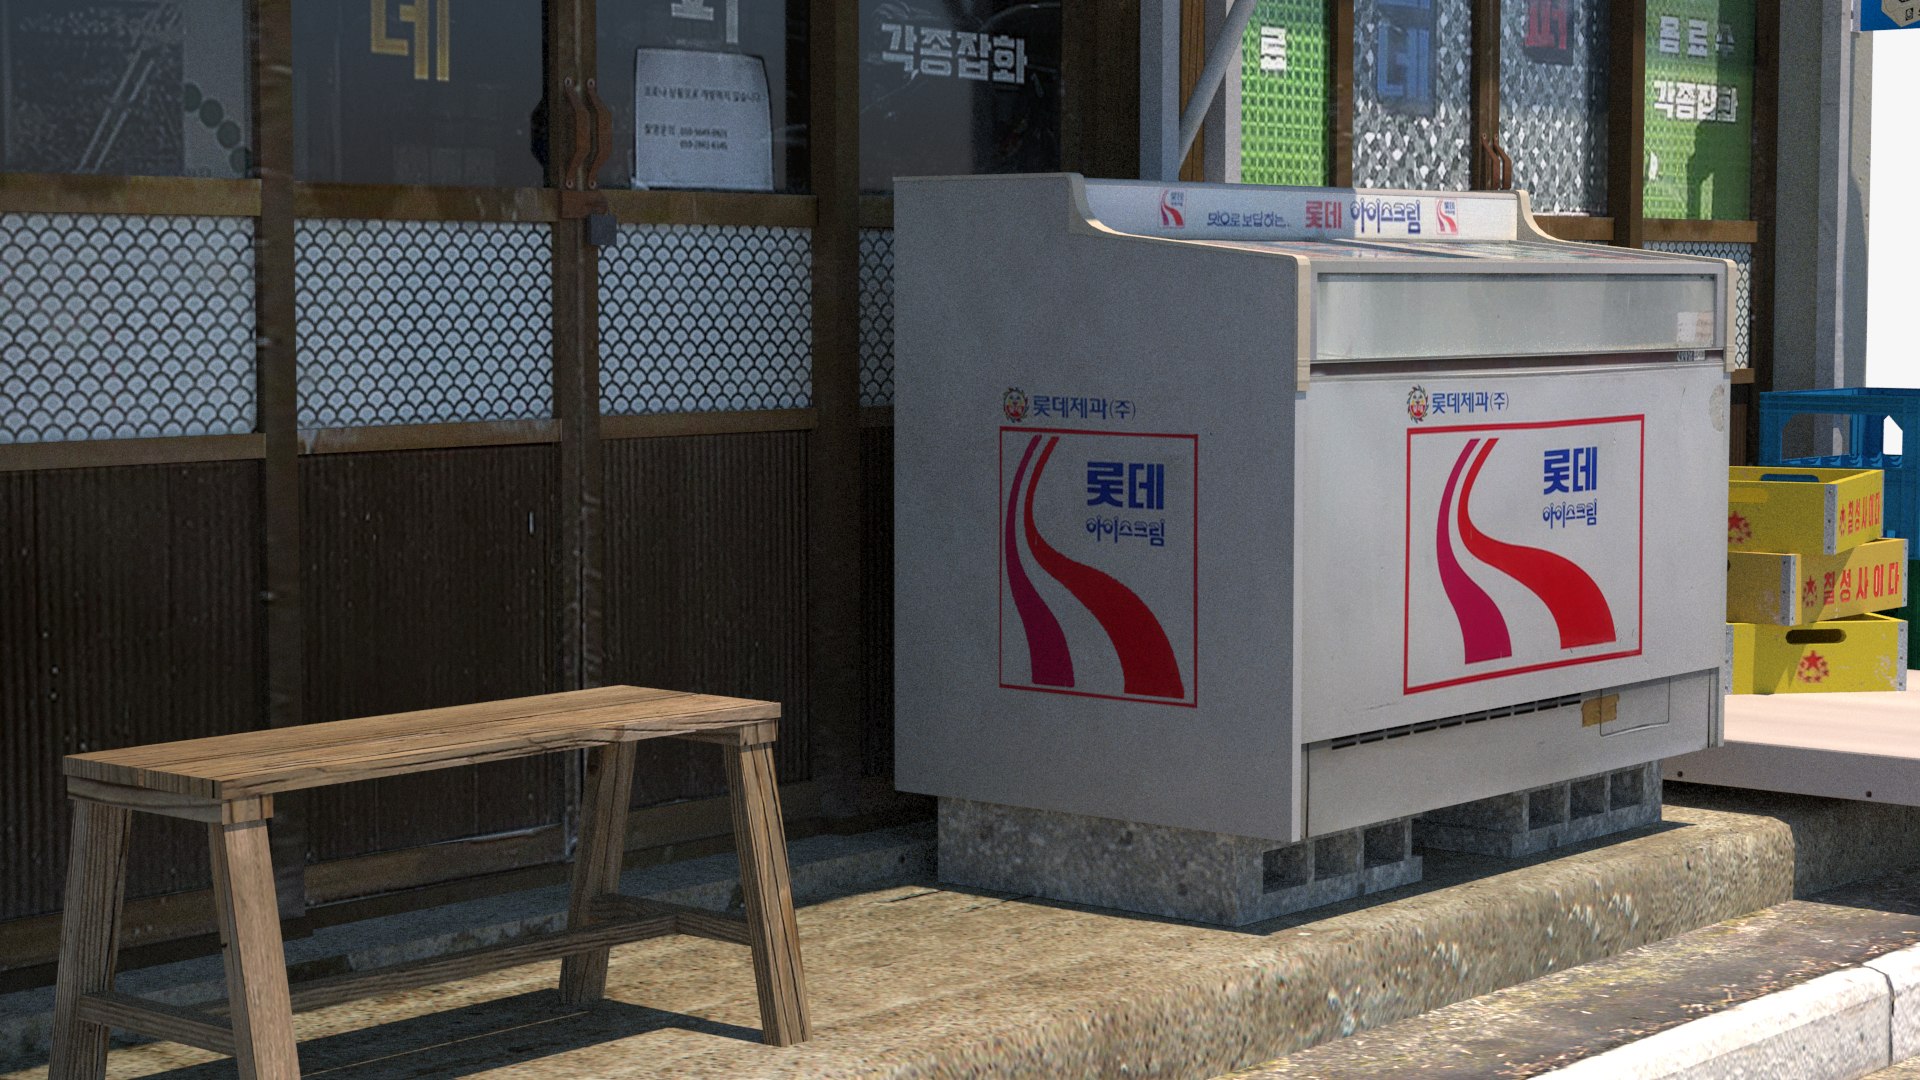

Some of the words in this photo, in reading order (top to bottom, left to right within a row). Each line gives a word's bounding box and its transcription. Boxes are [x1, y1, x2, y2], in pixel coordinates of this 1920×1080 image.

[881, 23, 1028, 84] 각종잡화
[1305, 200, 1343, 229] 롯데
[1350, 197, 1422, 234] 아이스크림
[1032, 395, 1136, 420] 롯데제과(주)
[1432, 391, 1509, 415] 롯데제과(주)
[1087, 461, 1164, 510] 롯데
[1543, 446, 1598, 495] 롯데
[1086, 515, 1165, 547] 아이스크림
[1542, 498, 1598, 529] 아이스크림
[1823, 562, 1900, 605] 칠성사이다
